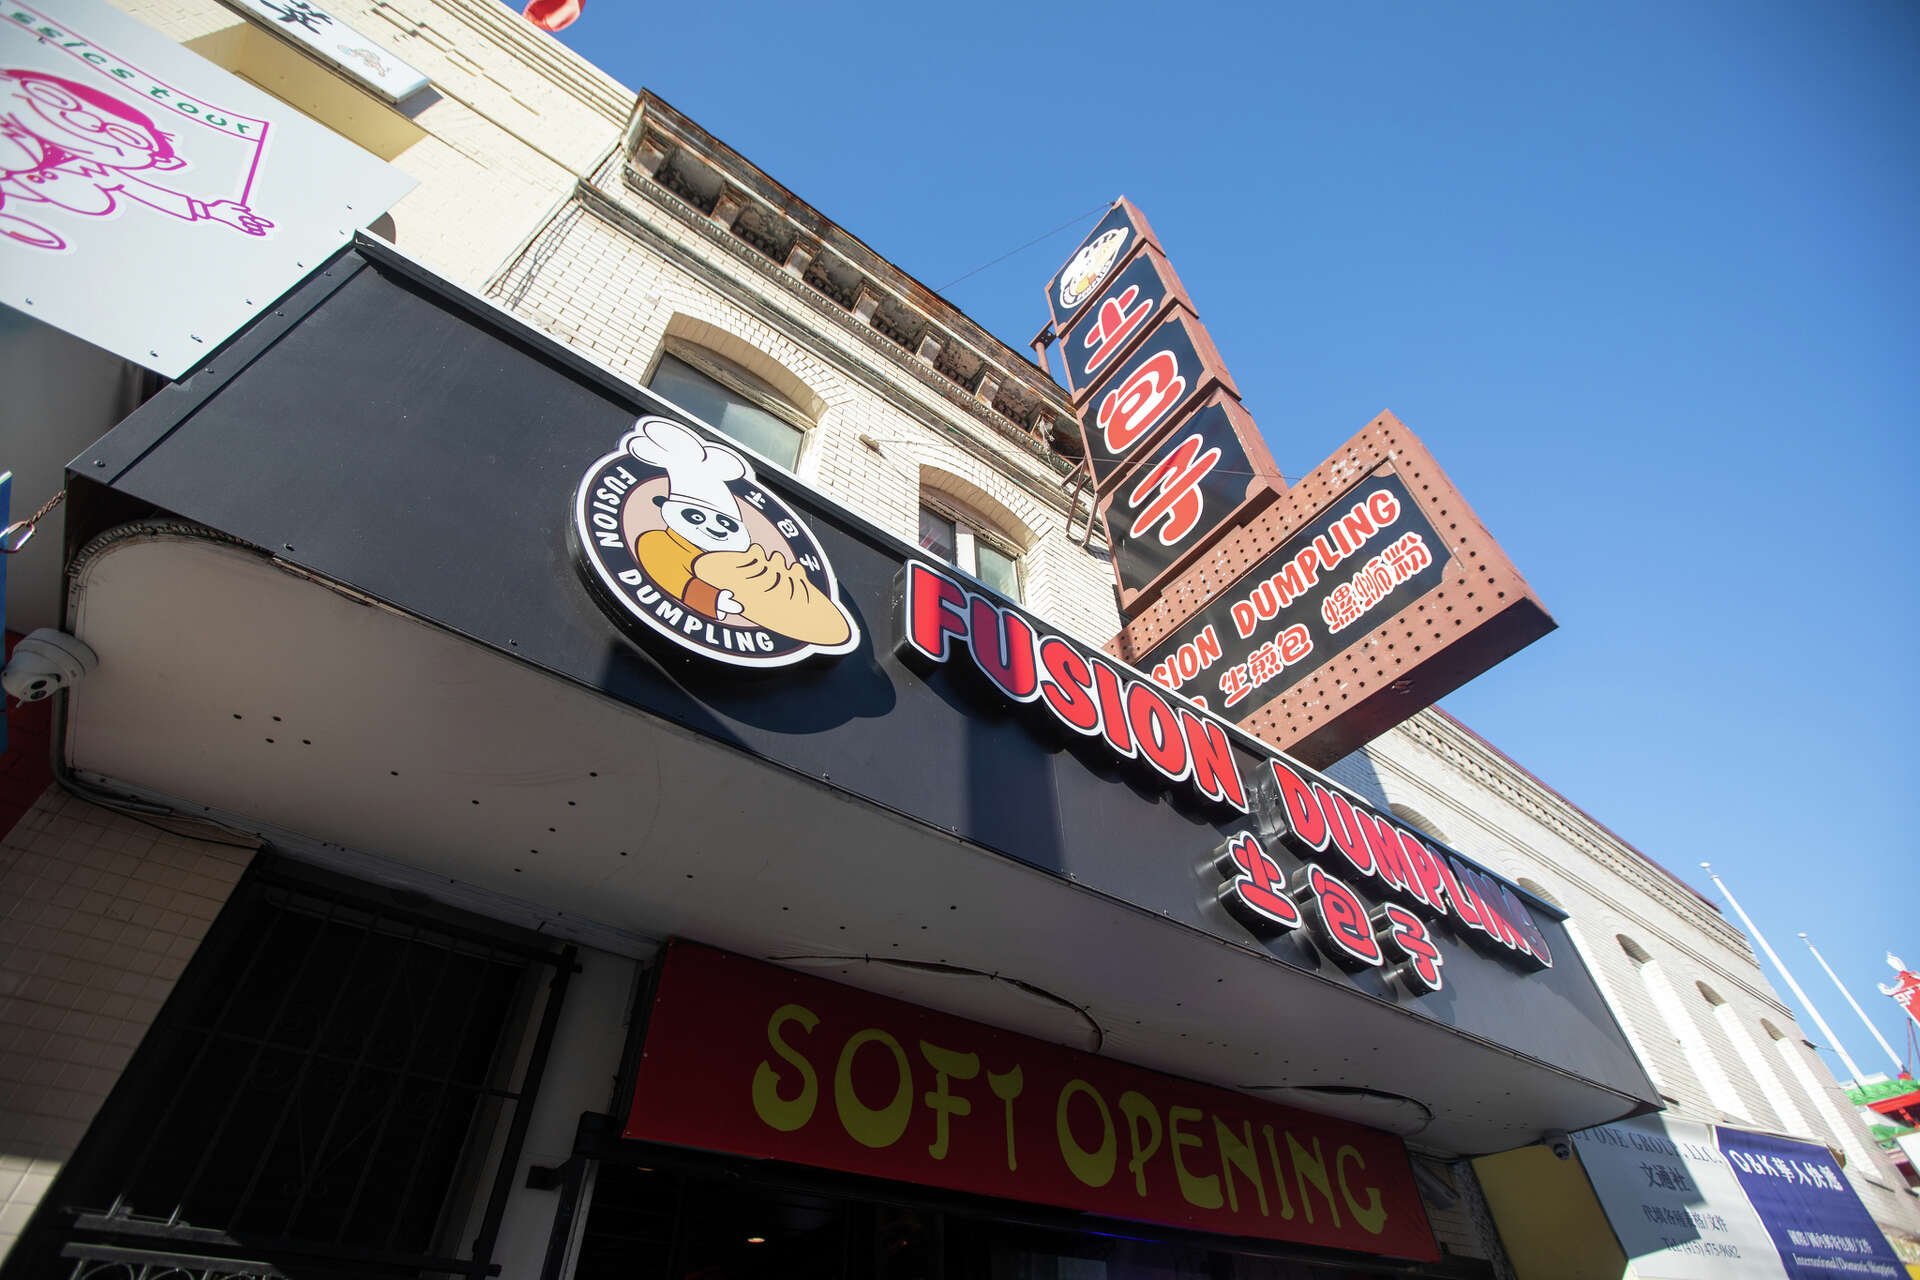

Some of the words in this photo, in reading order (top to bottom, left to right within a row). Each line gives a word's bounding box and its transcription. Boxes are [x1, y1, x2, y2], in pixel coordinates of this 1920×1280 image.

[150, 86, 249, 134] tour
[592, 466, 637, 548] FUSION
[1230, 489, 1400, 639] DUMPLING
[619, 569, 774, 651] DUMPLING
[1219, 623, 1313, 707] 生煎包
[905, 558, 1250, 814] FUSION
[1270, 758, 1553, 968] DUMPLING
[752, 1003, 1023, 1172] SOFT
[1056, 1079, 1388, 1234] OPENING
